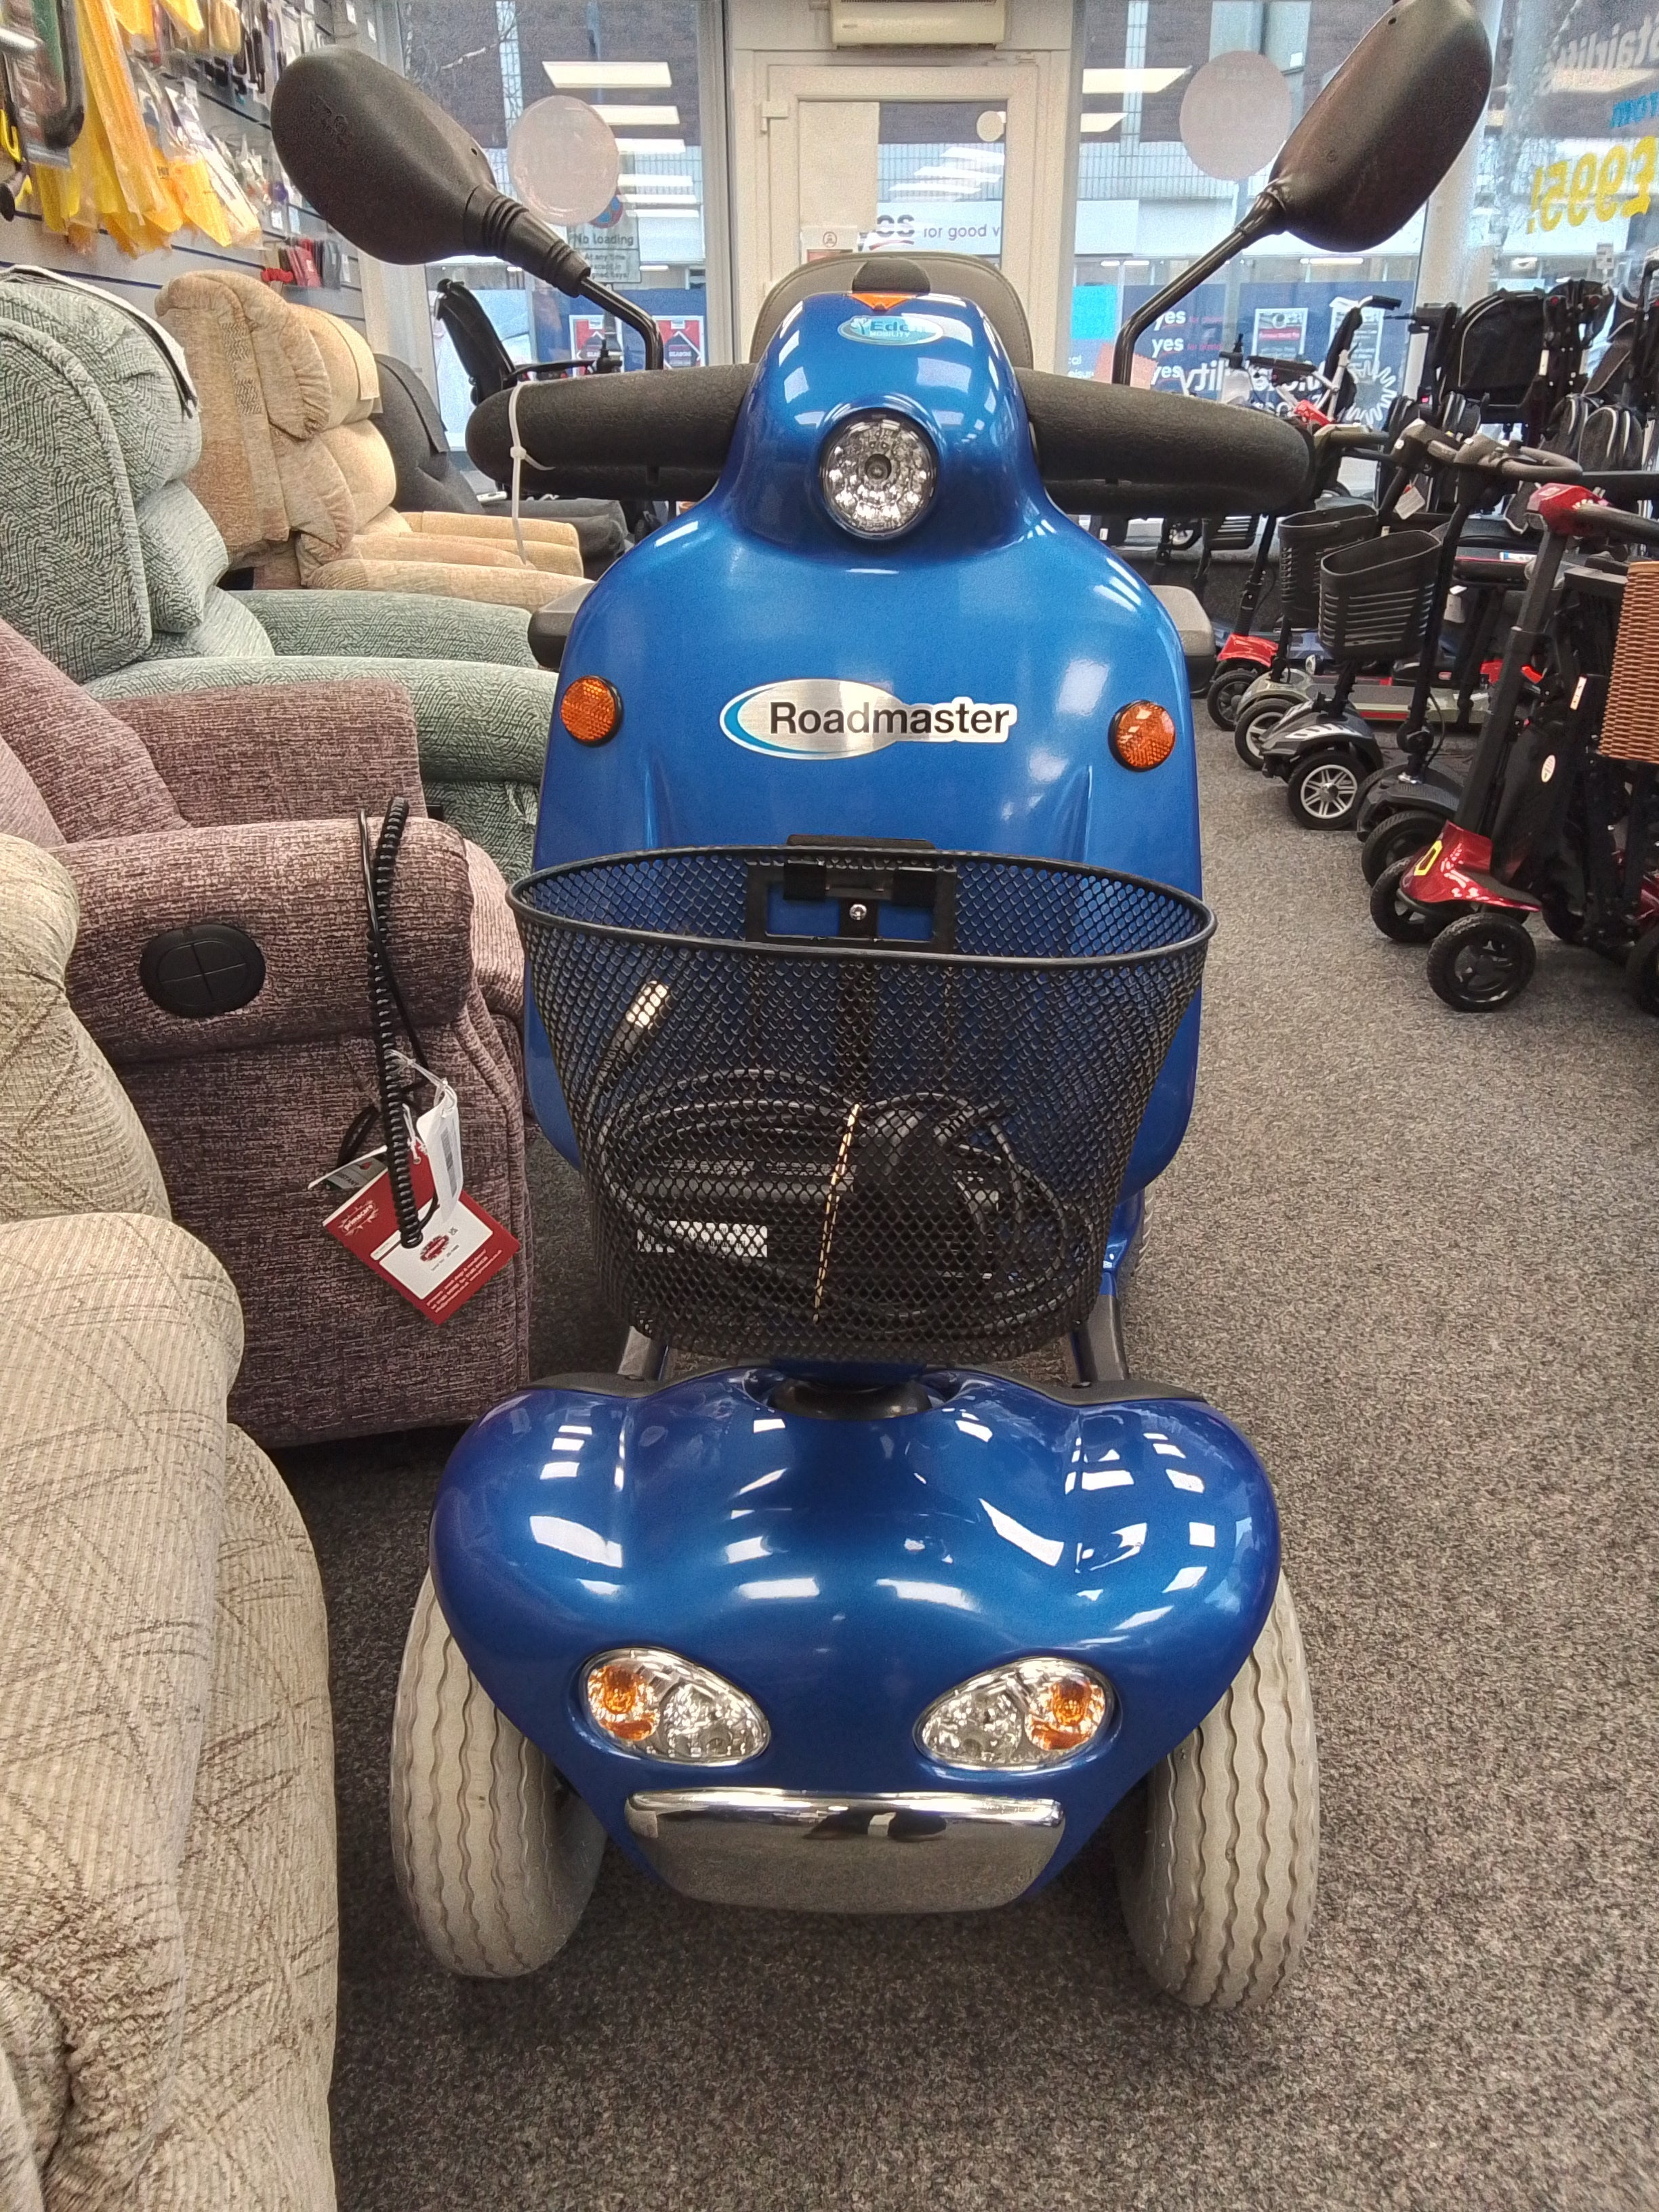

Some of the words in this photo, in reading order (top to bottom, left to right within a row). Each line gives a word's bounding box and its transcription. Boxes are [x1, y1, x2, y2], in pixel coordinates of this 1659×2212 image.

[574, 233, 590, 245] No
[593, 233, 634, 246] loading
[949, 224, 987, 241] good
[1153, 310, 1186, 331] yes
[1151, 338, 1185, 359] yes
[1150, 364, 1181, 386] yes
[770, 701, 1010, 735] Roadmaster
[343, 1203, 374, 1231] primacare
